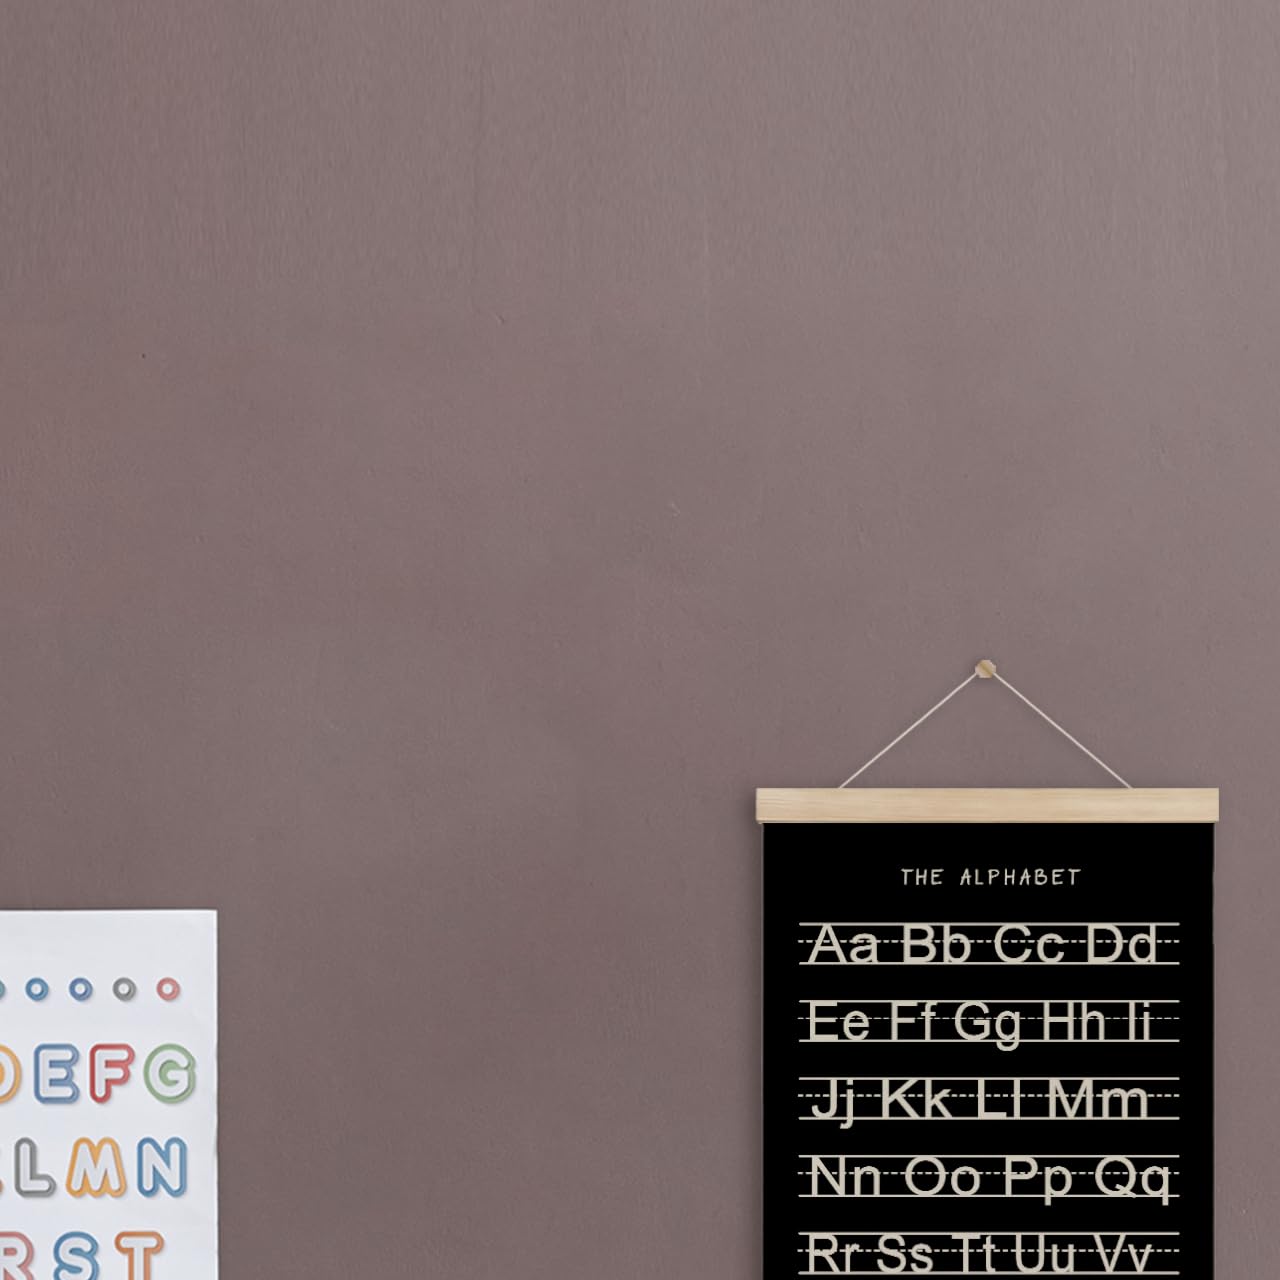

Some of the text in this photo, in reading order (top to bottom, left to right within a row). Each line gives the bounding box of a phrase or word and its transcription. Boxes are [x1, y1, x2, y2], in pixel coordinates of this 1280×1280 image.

[900, 867, 1082, 886] THE ALPHABET
[807, 924, 1157, 964] Aa Bb Cc Dd
[809, 1001, 1151, 1051] Ee Ff Gg Hh Ii
[811, 1078, 1148, 1128] Jj Kk Ll Mm
[811, 1156, 1169, 1205] Nn Oo Pp Qq
[808, 1233, 1153, 1274] Rr Ss Tt Uu Vv
